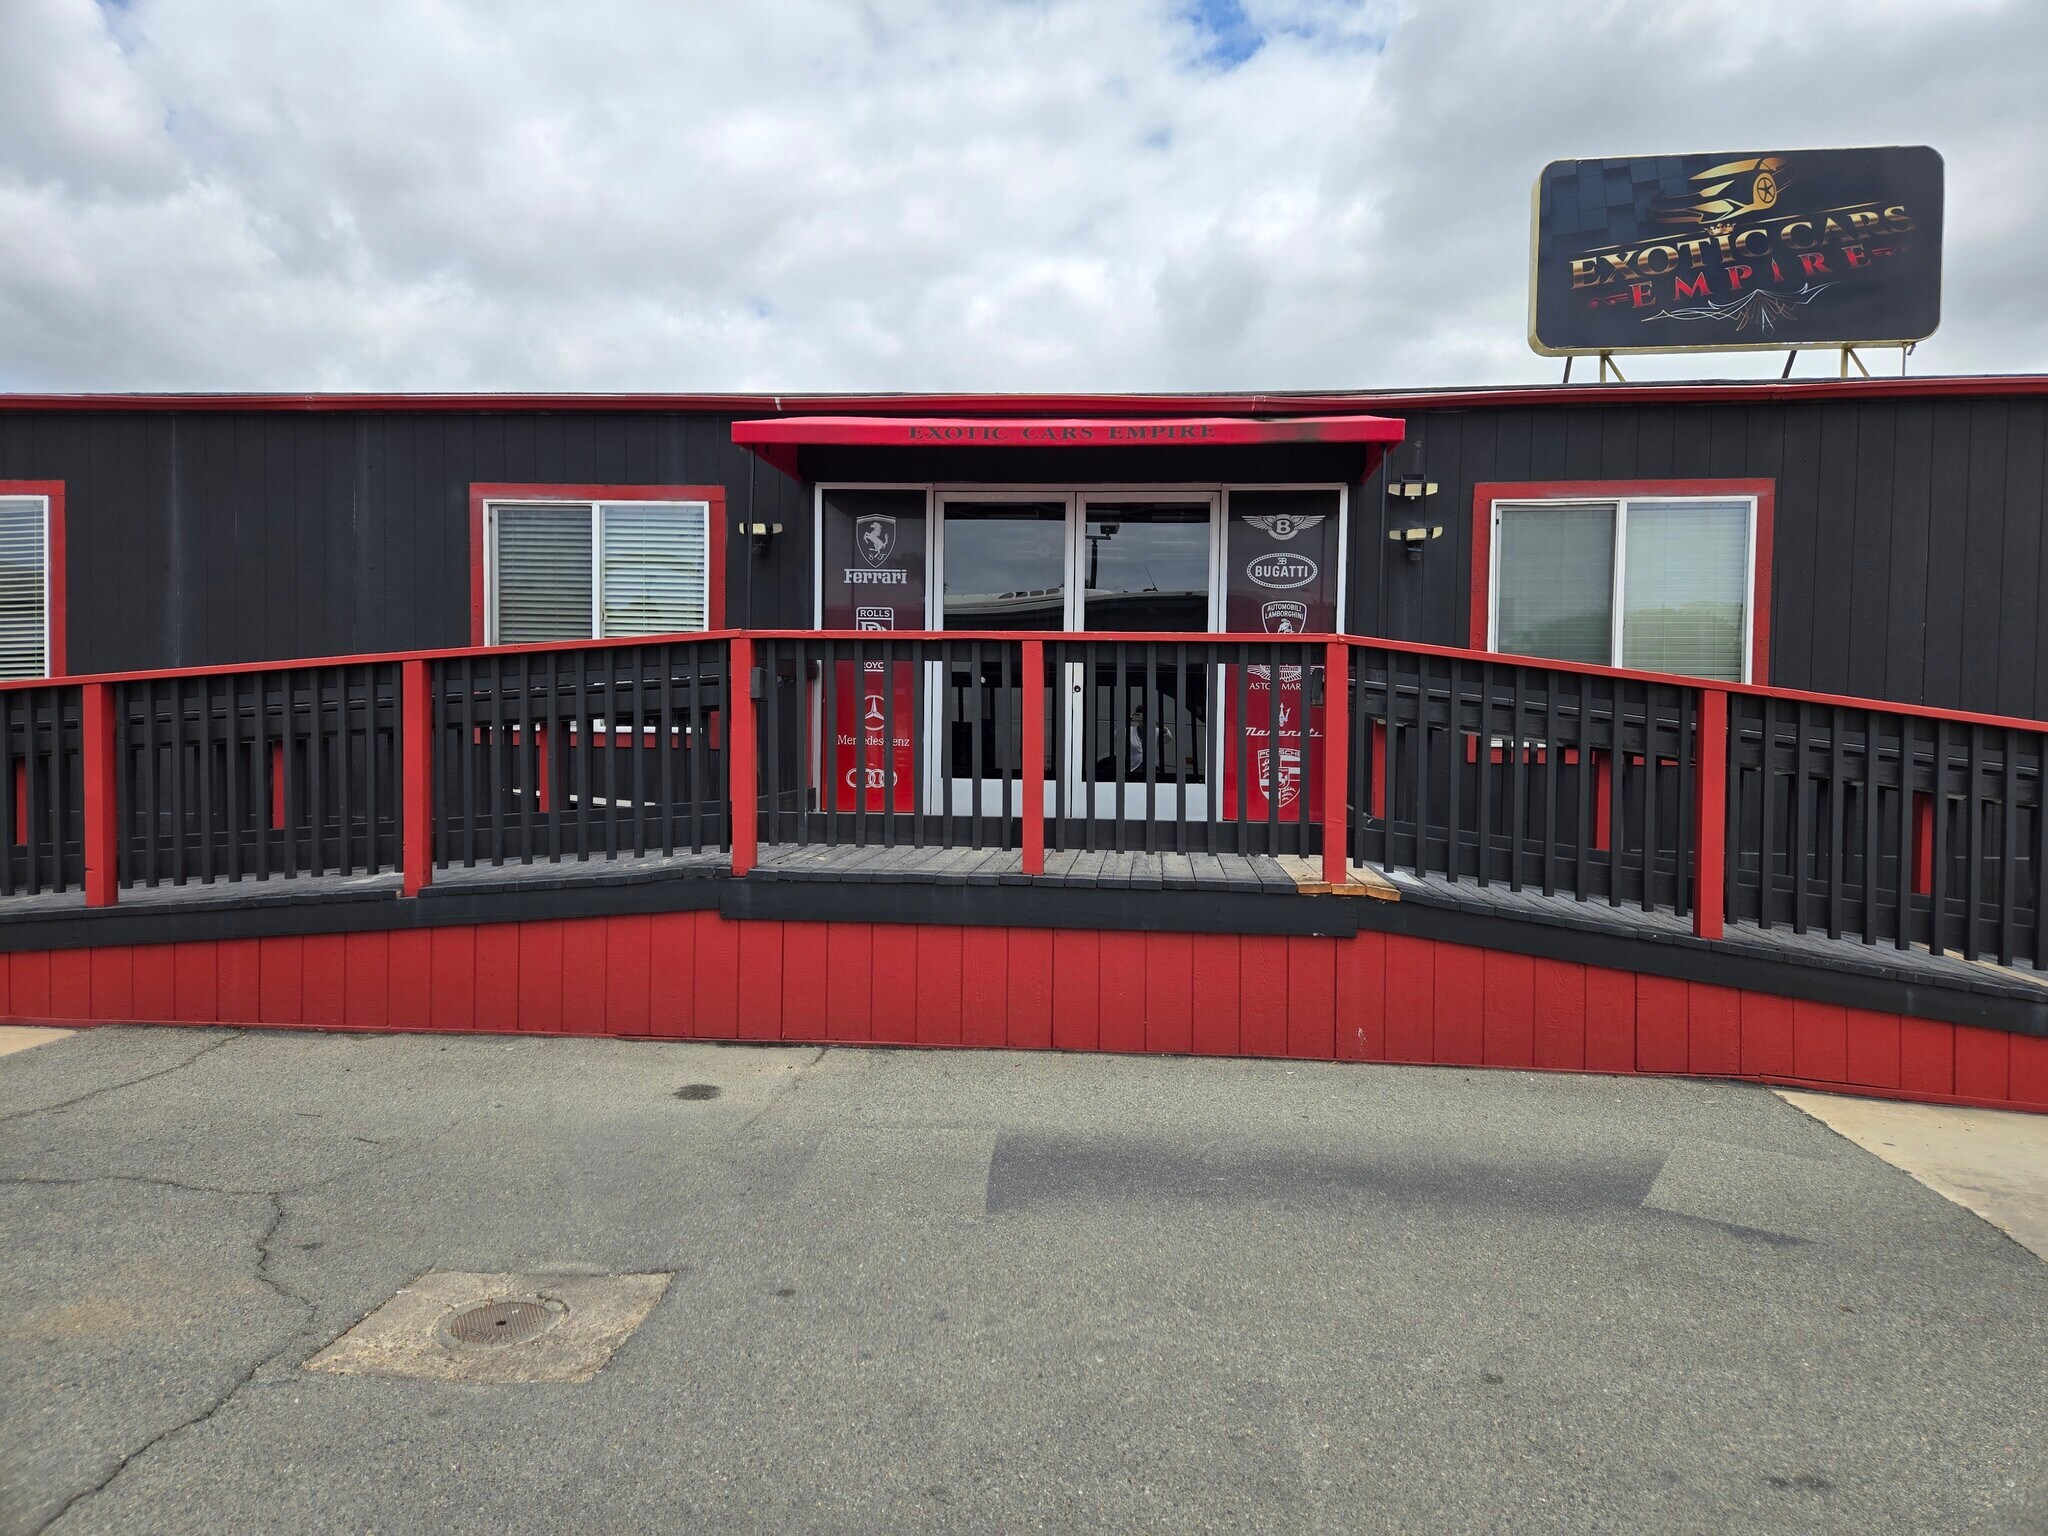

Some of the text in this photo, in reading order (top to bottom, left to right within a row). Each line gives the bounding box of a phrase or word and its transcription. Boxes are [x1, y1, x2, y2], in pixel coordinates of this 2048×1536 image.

[1569, 205, 1916, 290] EXOTIC CARS
[1629, 243, 1874, 308] EMPIRE
[909, 424, 1216, 440] EXOTIC CARS EMPIRE
[1276, 519, 1291, 534] B
[843, 568, 907, 584] Ferrari
[1255, 565, 1308, 577] BUGATTI
[860, 609, 890, 618] ROLLS
[1265, 610, 1304, 620] LAMBORGHINI
[1267, 603, 1302, 612] AUTOMOBILI
